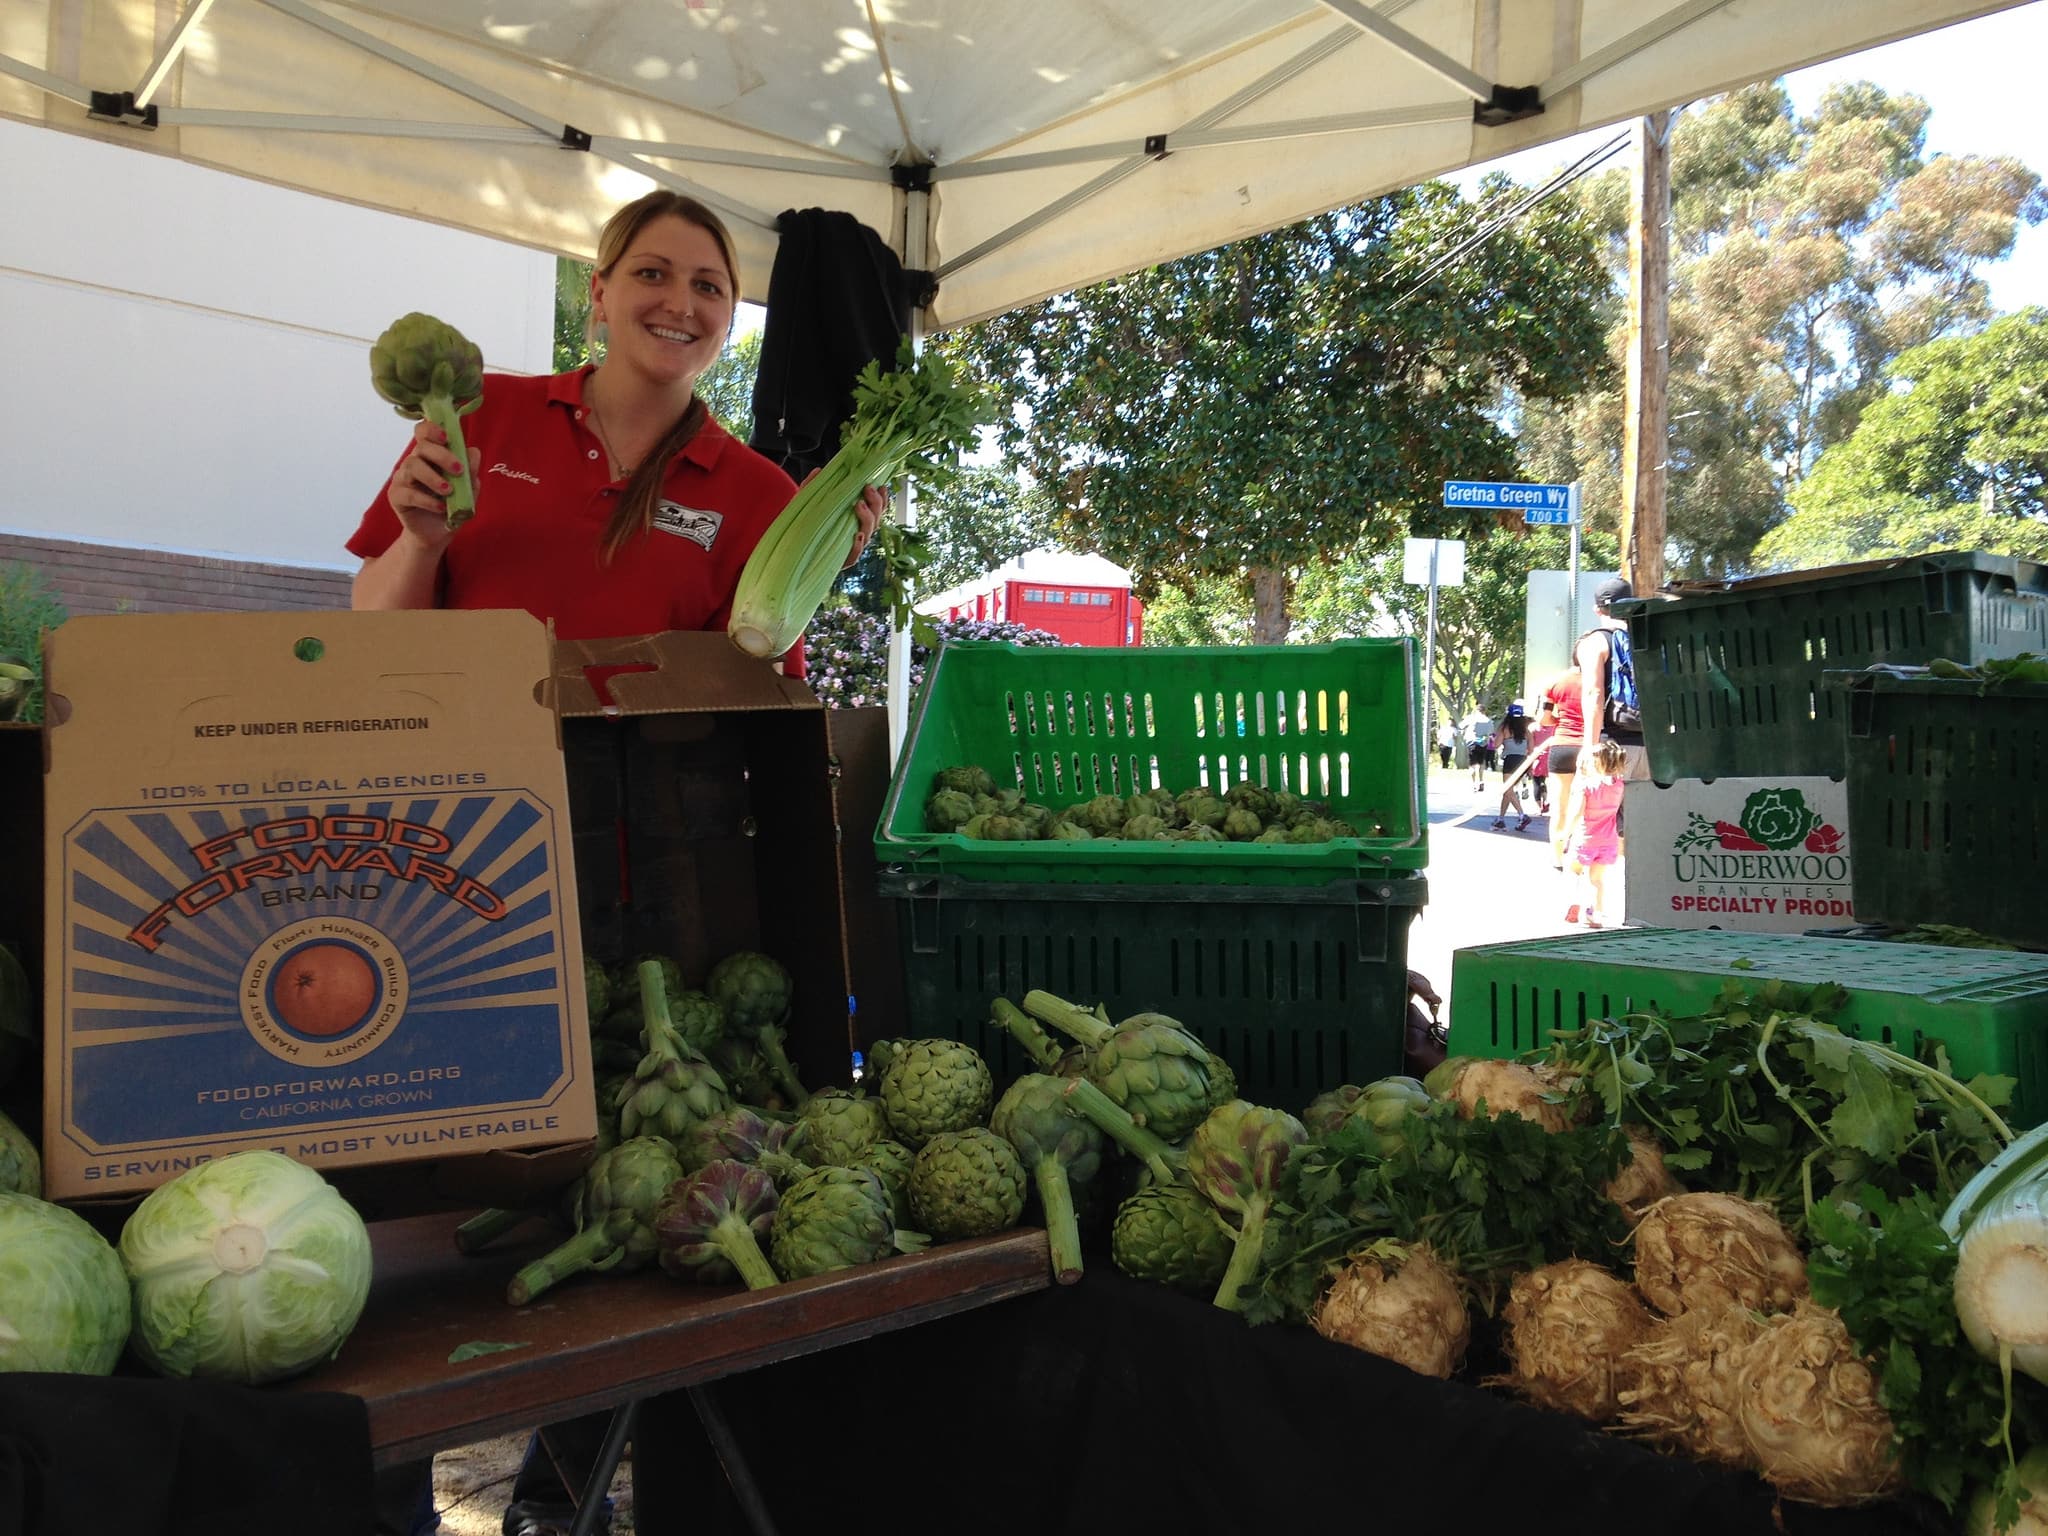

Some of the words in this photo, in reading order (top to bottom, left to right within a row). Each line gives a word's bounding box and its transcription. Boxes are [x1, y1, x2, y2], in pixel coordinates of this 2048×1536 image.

[488, 463, 540, 484] Jessica
[1448, 484, 1496, 502] Gretna
[1500, 486, 1543, 504] Green
[1546, 488, 1567, 508] Wy
[1531, 511, 1552, 522] 700
[1556, 511, 1563, 522] S
[194, 725, 236, 738] KEEP
[241, 722, 298, 736] UNDER
[303, 717, 429, 734] REFRIGERATION
[140, 784, 207, 800] 100%
[215, 783, 250, 796] TO
[262, 779, 348, 794] LOCAL
[357, 772, 487, 790] AGENCIES
[191, 814, 451, 873] FOOD
[1672, 854, 1851, 883] UNDERWOO
[126, 845, 508, 954] FORWARD
[261, 884, 382, 908] BRAND
[1671, 895, 1778, 914] SPECIALTY
[1698, 885, 1834, 898] RANCHES
[321, 924, 380, 950] HUNGER
[248, 959, 268, 998] FOOD
[383, 957, 398, 998] BUILD
[250, 1005, 300, 1056] HARVEST
[324, 1003, 396, 1058] COMMUNITY
[197, 1066, 462, 1104] FOODFORWARD.ORG
[240, 1098, 352, 1120] CALIFORNIA
[358, 1089, 433, 1108] GROWN
[299, 1136, 375, 1156] MOST
[384, 1116, 559, 1146] VULNERABLE
